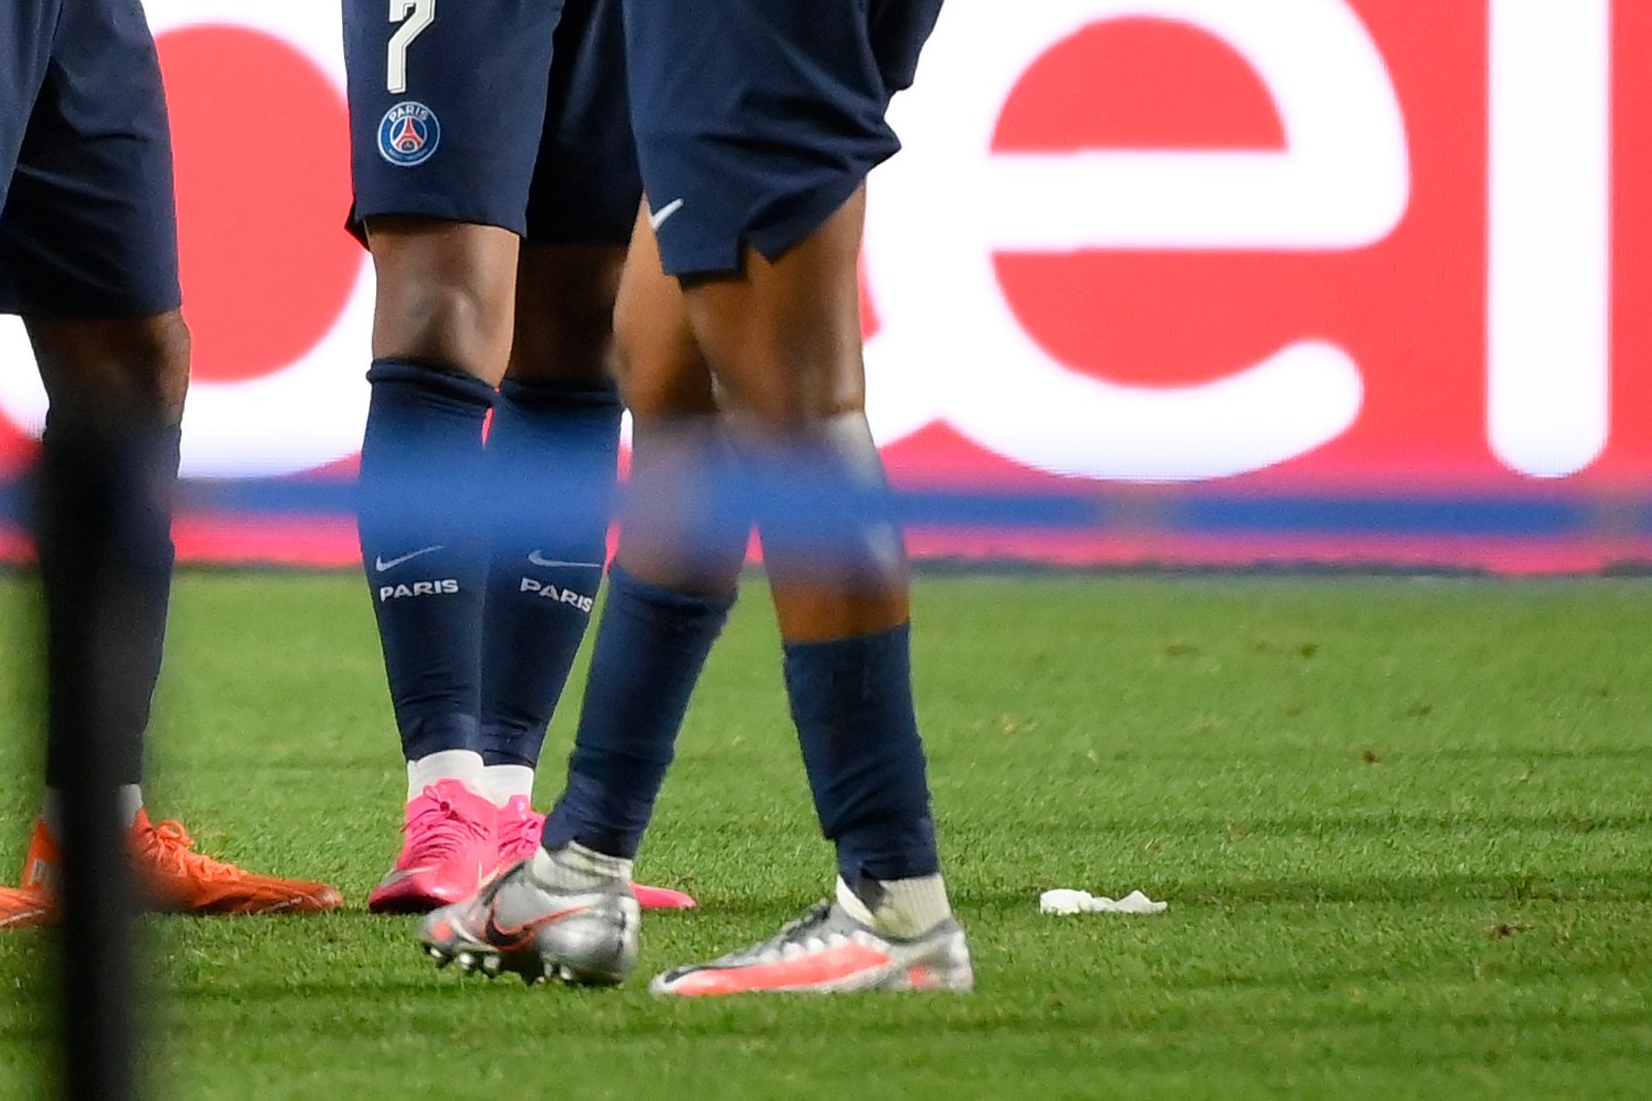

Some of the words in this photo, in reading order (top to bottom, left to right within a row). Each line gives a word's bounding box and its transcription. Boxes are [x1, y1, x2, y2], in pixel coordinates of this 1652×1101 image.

[388, 105, 429, 123] PARIS
[379, 578, 460, 602] PARIS
[520, 576, 594, 613] PARIS
